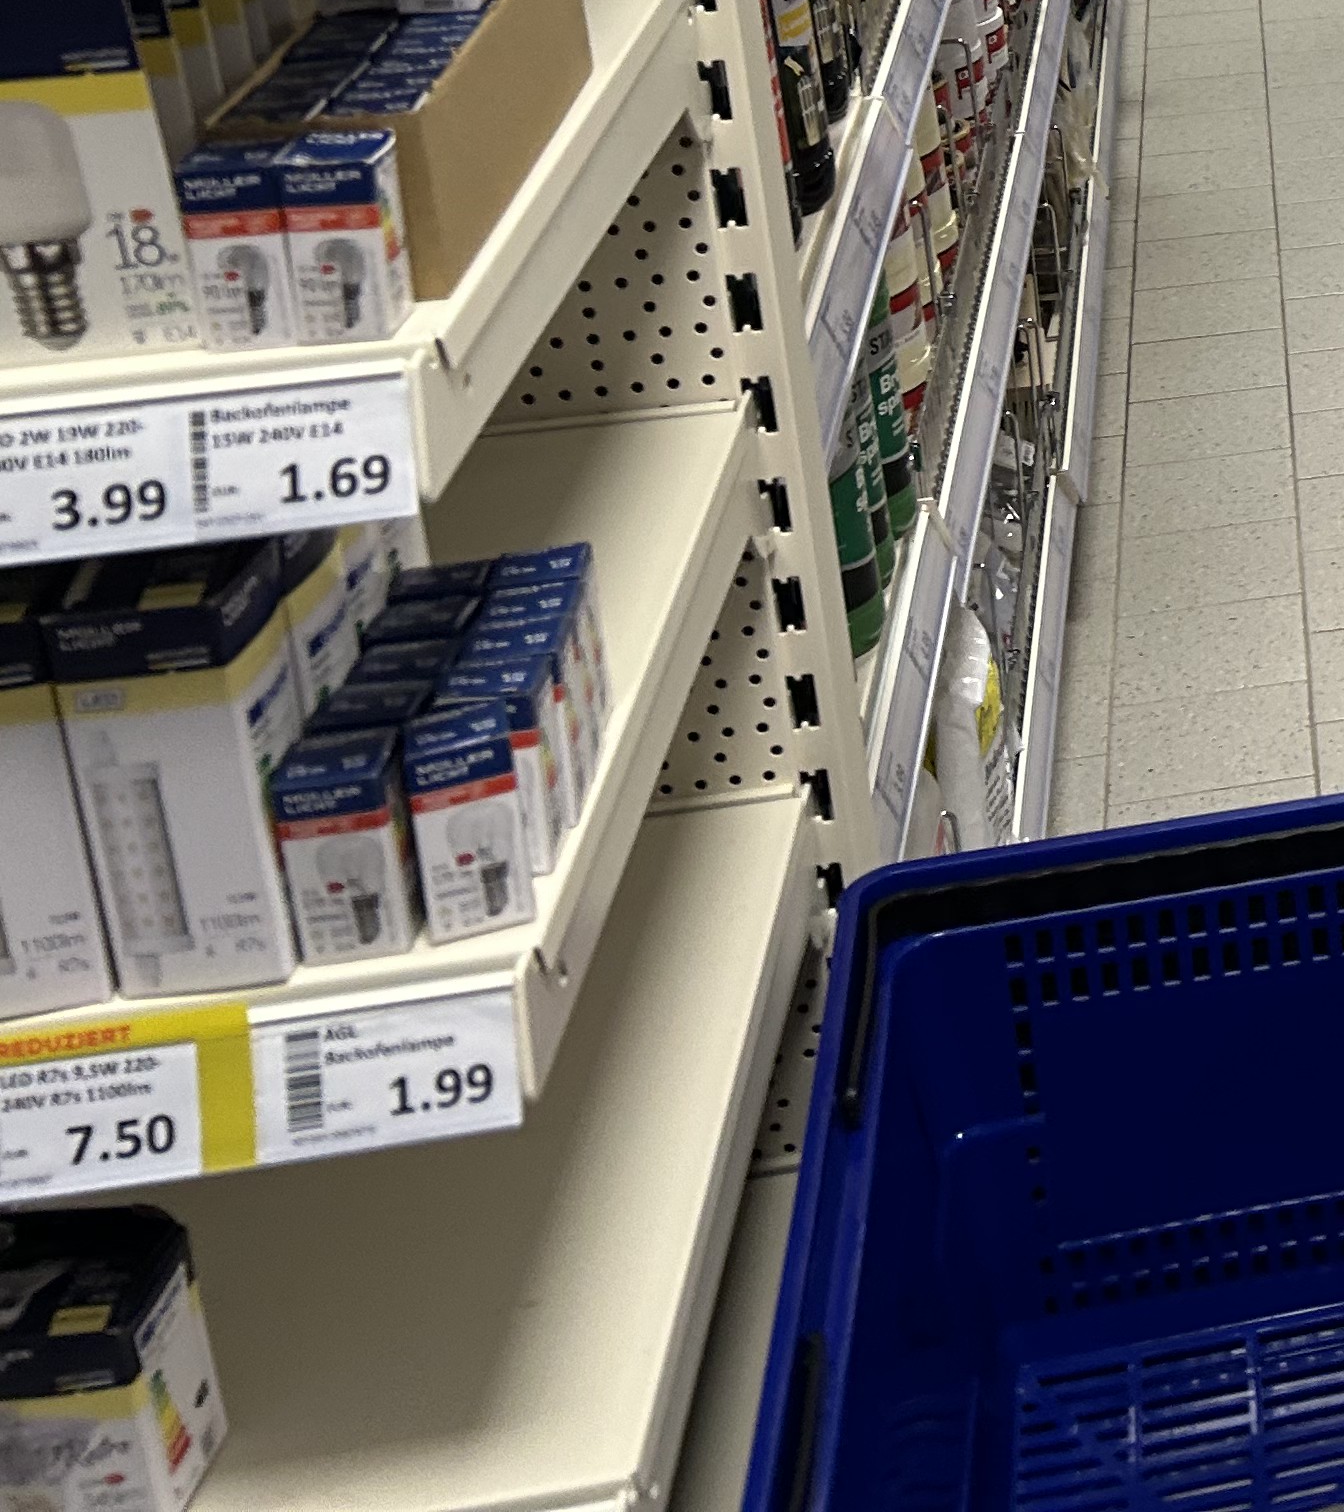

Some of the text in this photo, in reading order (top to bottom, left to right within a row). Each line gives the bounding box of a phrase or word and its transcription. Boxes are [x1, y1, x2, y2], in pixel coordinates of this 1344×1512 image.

[211, 399, 351, 423] Backofenlampe
[280, 454, 390, 504] 1.69
[51, 479, 166, 530] 3.99
[325, 1035, 455, 1065] Backofenlampe
[389, 1063, 493, 1117] 1.99
[66, 1114, 175, 1166] 7.50
